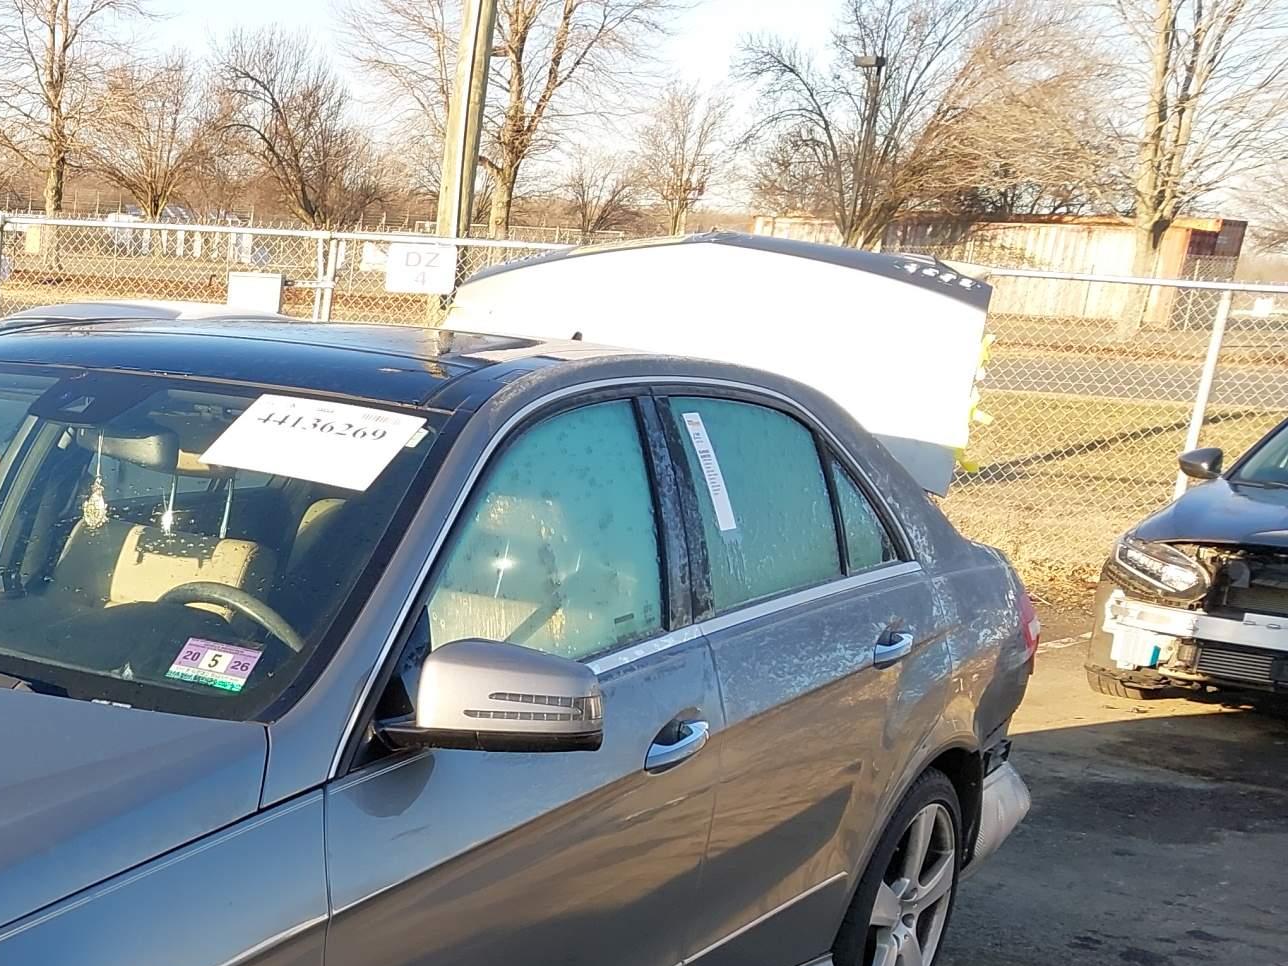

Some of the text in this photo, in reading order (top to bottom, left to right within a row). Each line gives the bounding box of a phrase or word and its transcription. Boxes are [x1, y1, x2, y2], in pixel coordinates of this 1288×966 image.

[405, 251, 440, 267] DZ
[413, 271, 426, 286] 4
[257, 412, 387, 441] 44136269
[182, 650, 201, 662] 20
[208, 654, 222, 668] 5
[230, 660, 250, 672] 26
